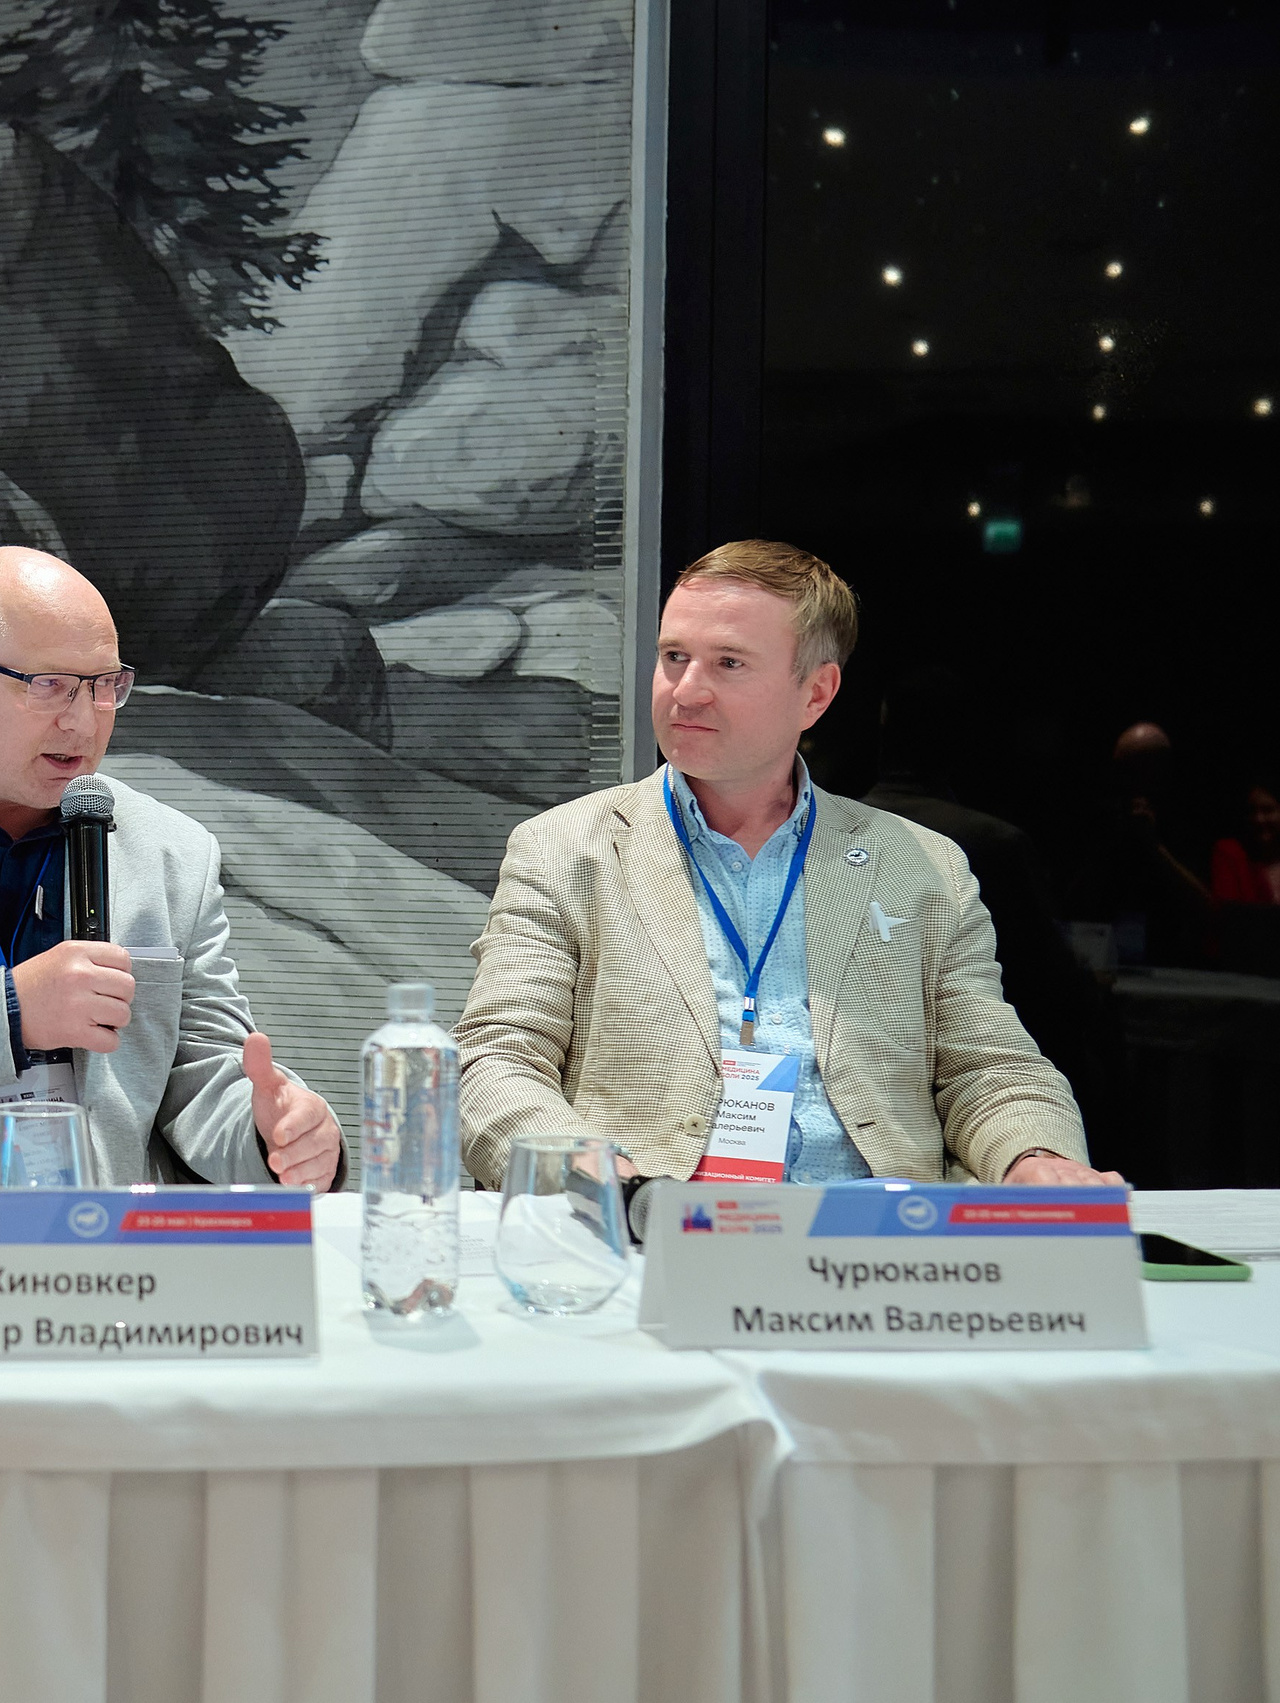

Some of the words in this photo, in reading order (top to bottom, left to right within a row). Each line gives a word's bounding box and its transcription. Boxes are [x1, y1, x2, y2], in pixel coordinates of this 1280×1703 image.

[718, 1098, 775, 1112] РЮКАНОВ
[716, 1110, 757, 1121] Максим
[711, 1121, 766, 1134] алерьевич
[718, 1137, 746, 1146] Москва
[695, 1170, 744, 1181] НИЗАЦИОННЫЙ
[745, 1174, 776, 1184] КОМИТЕТ
[807, 1256, 1002, 1290] Чурюканов
[732, 1306, 874, 1334] Максим
[884, 1306, 1087, 1339] Валерьевич
[35, 1317, 304, 1353] Владимирович
